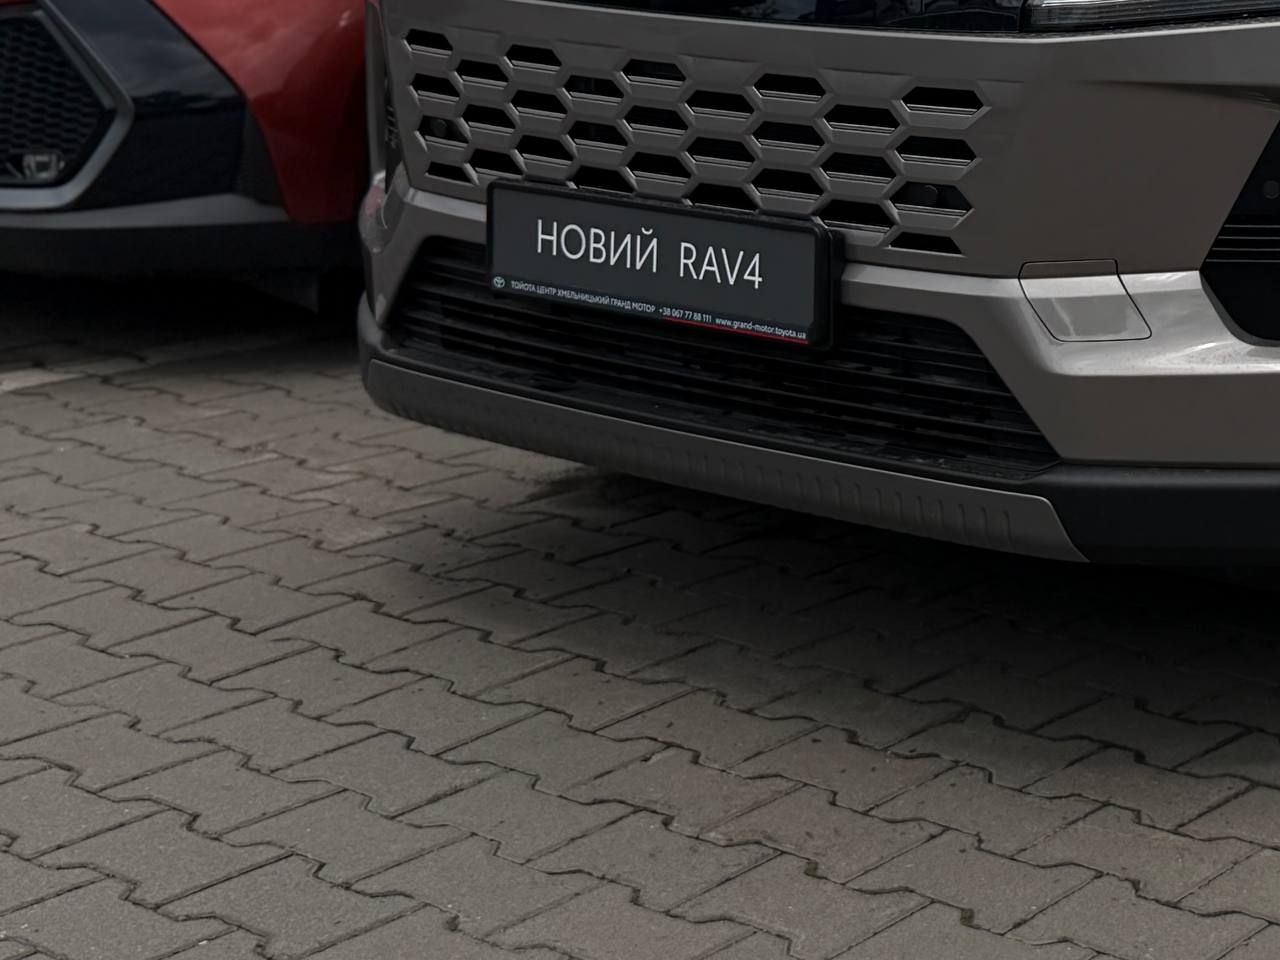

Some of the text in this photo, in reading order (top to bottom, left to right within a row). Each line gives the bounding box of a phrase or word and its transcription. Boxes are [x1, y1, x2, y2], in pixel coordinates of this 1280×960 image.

[537, 218, 763, 289] НОВИЙ RAV4
[511, 280, 536, 292] ТОЙОТА
[536, 285, 557, 296] ЦЕНТР
[610, 297, 631, 310] ГРАНД
[631, 302, 656, 313] МОТОР
[671, 308, 683, 318] 067
[684, 310, 693, 320] 77
[715, 317, 807, 340] www.grand-motor.toyota.ua
